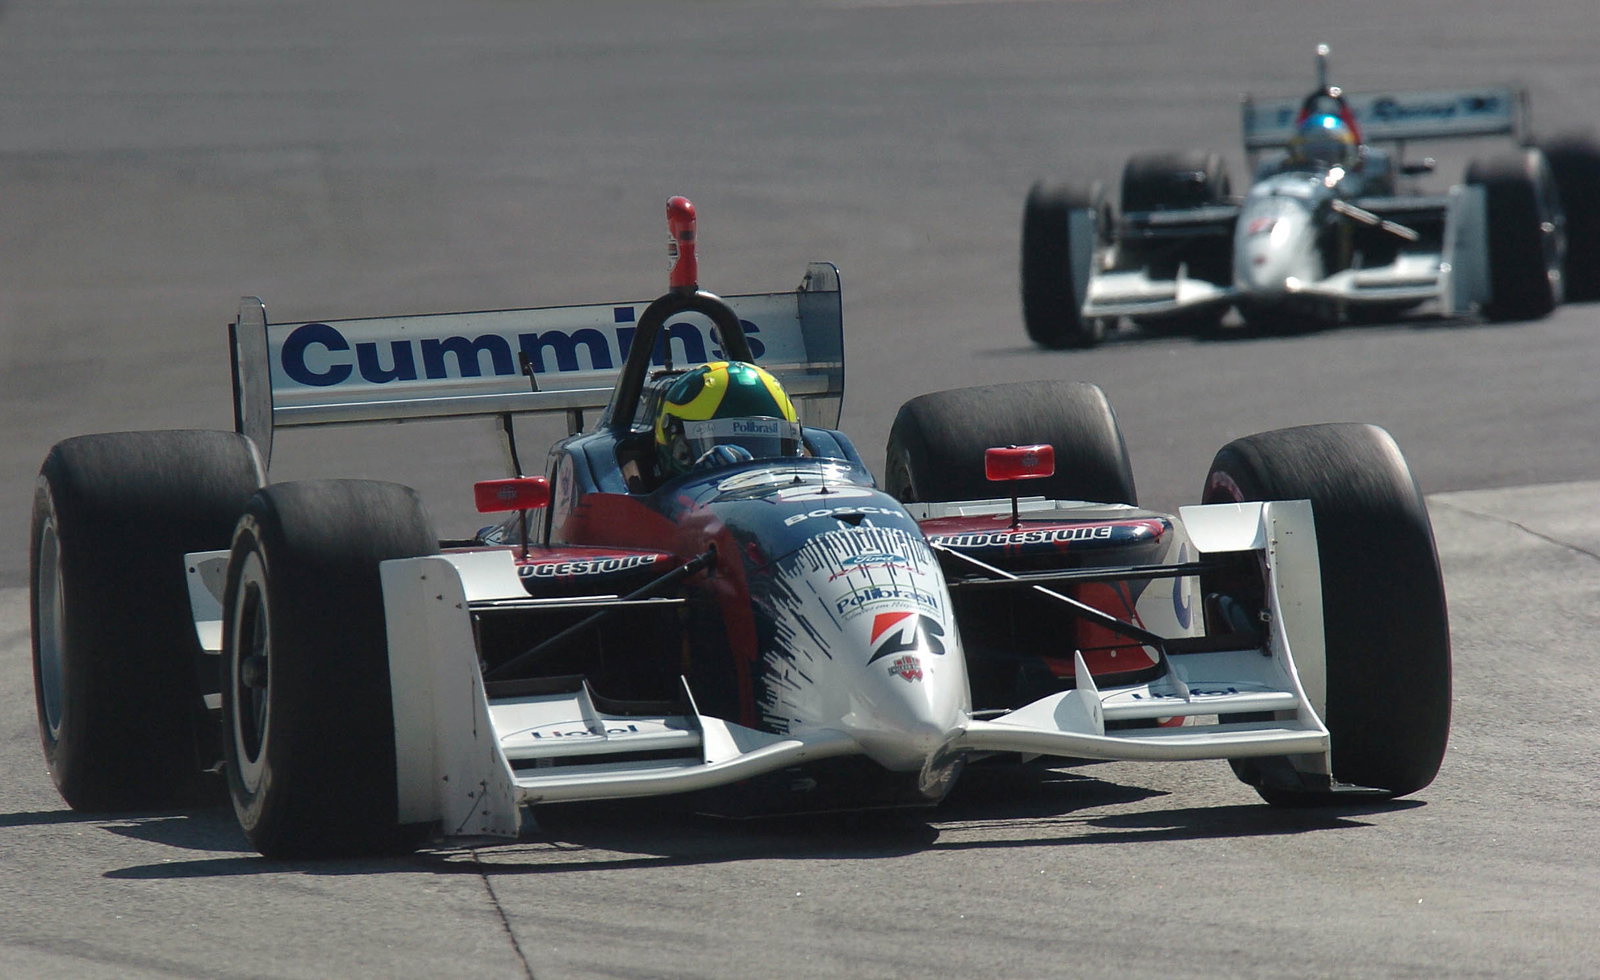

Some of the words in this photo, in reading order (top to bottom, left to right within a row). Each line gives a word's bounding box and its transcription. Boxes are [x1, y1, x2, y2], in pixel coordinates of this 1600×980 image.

[281, 307, 765, 386] Cummins
[733, 420, 778, 433] Polibrasil
[783, 507, 904, 527] BOSCH
[836, 588, 939, 614] Polibrasil
